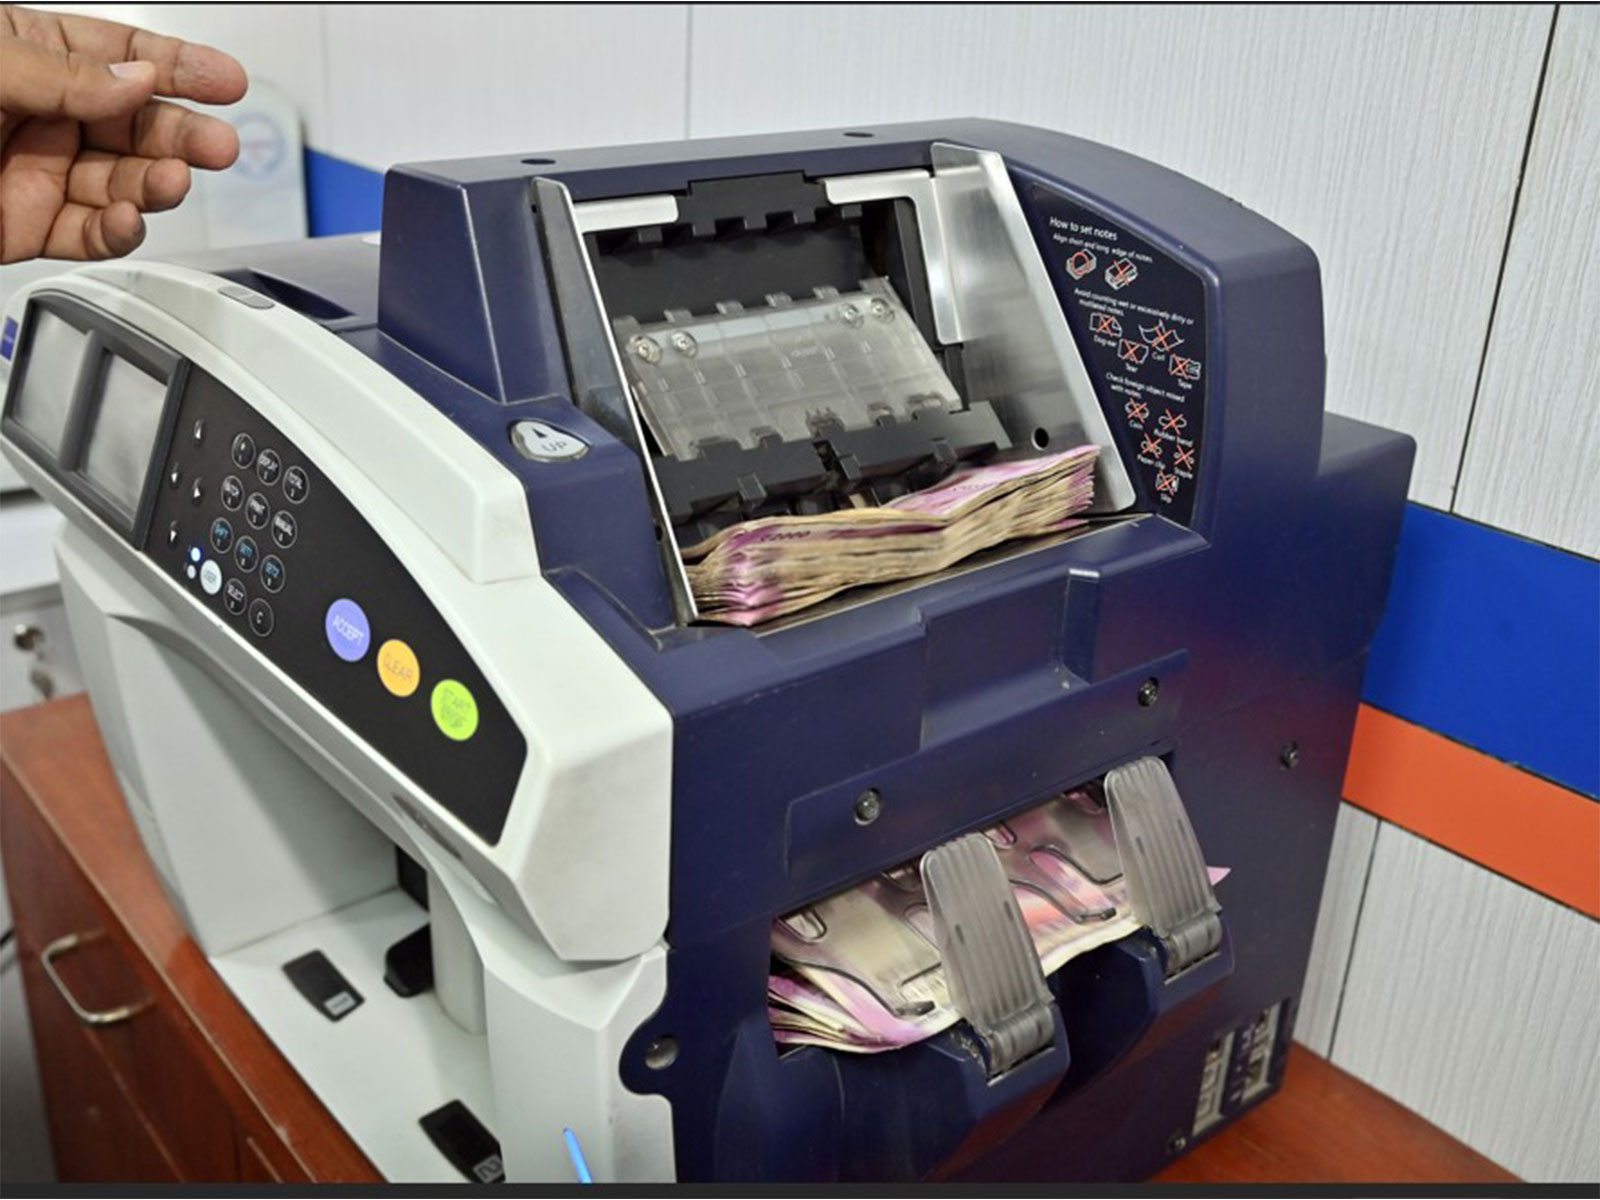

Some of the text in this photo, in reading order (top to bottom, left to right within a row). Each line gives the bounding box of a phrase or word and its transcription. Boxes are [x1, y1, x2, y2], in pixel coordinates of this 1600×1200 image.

[1050, 217, 1118, 241] How to set notes
[1053, 234, 1068, 244] Align
[1084, 240, 1095, 249] and
[1111, 247, 1127, 258] edge
[541, 441, 568, 452] UP
[332, 615, 365, 646] ACCEPT
